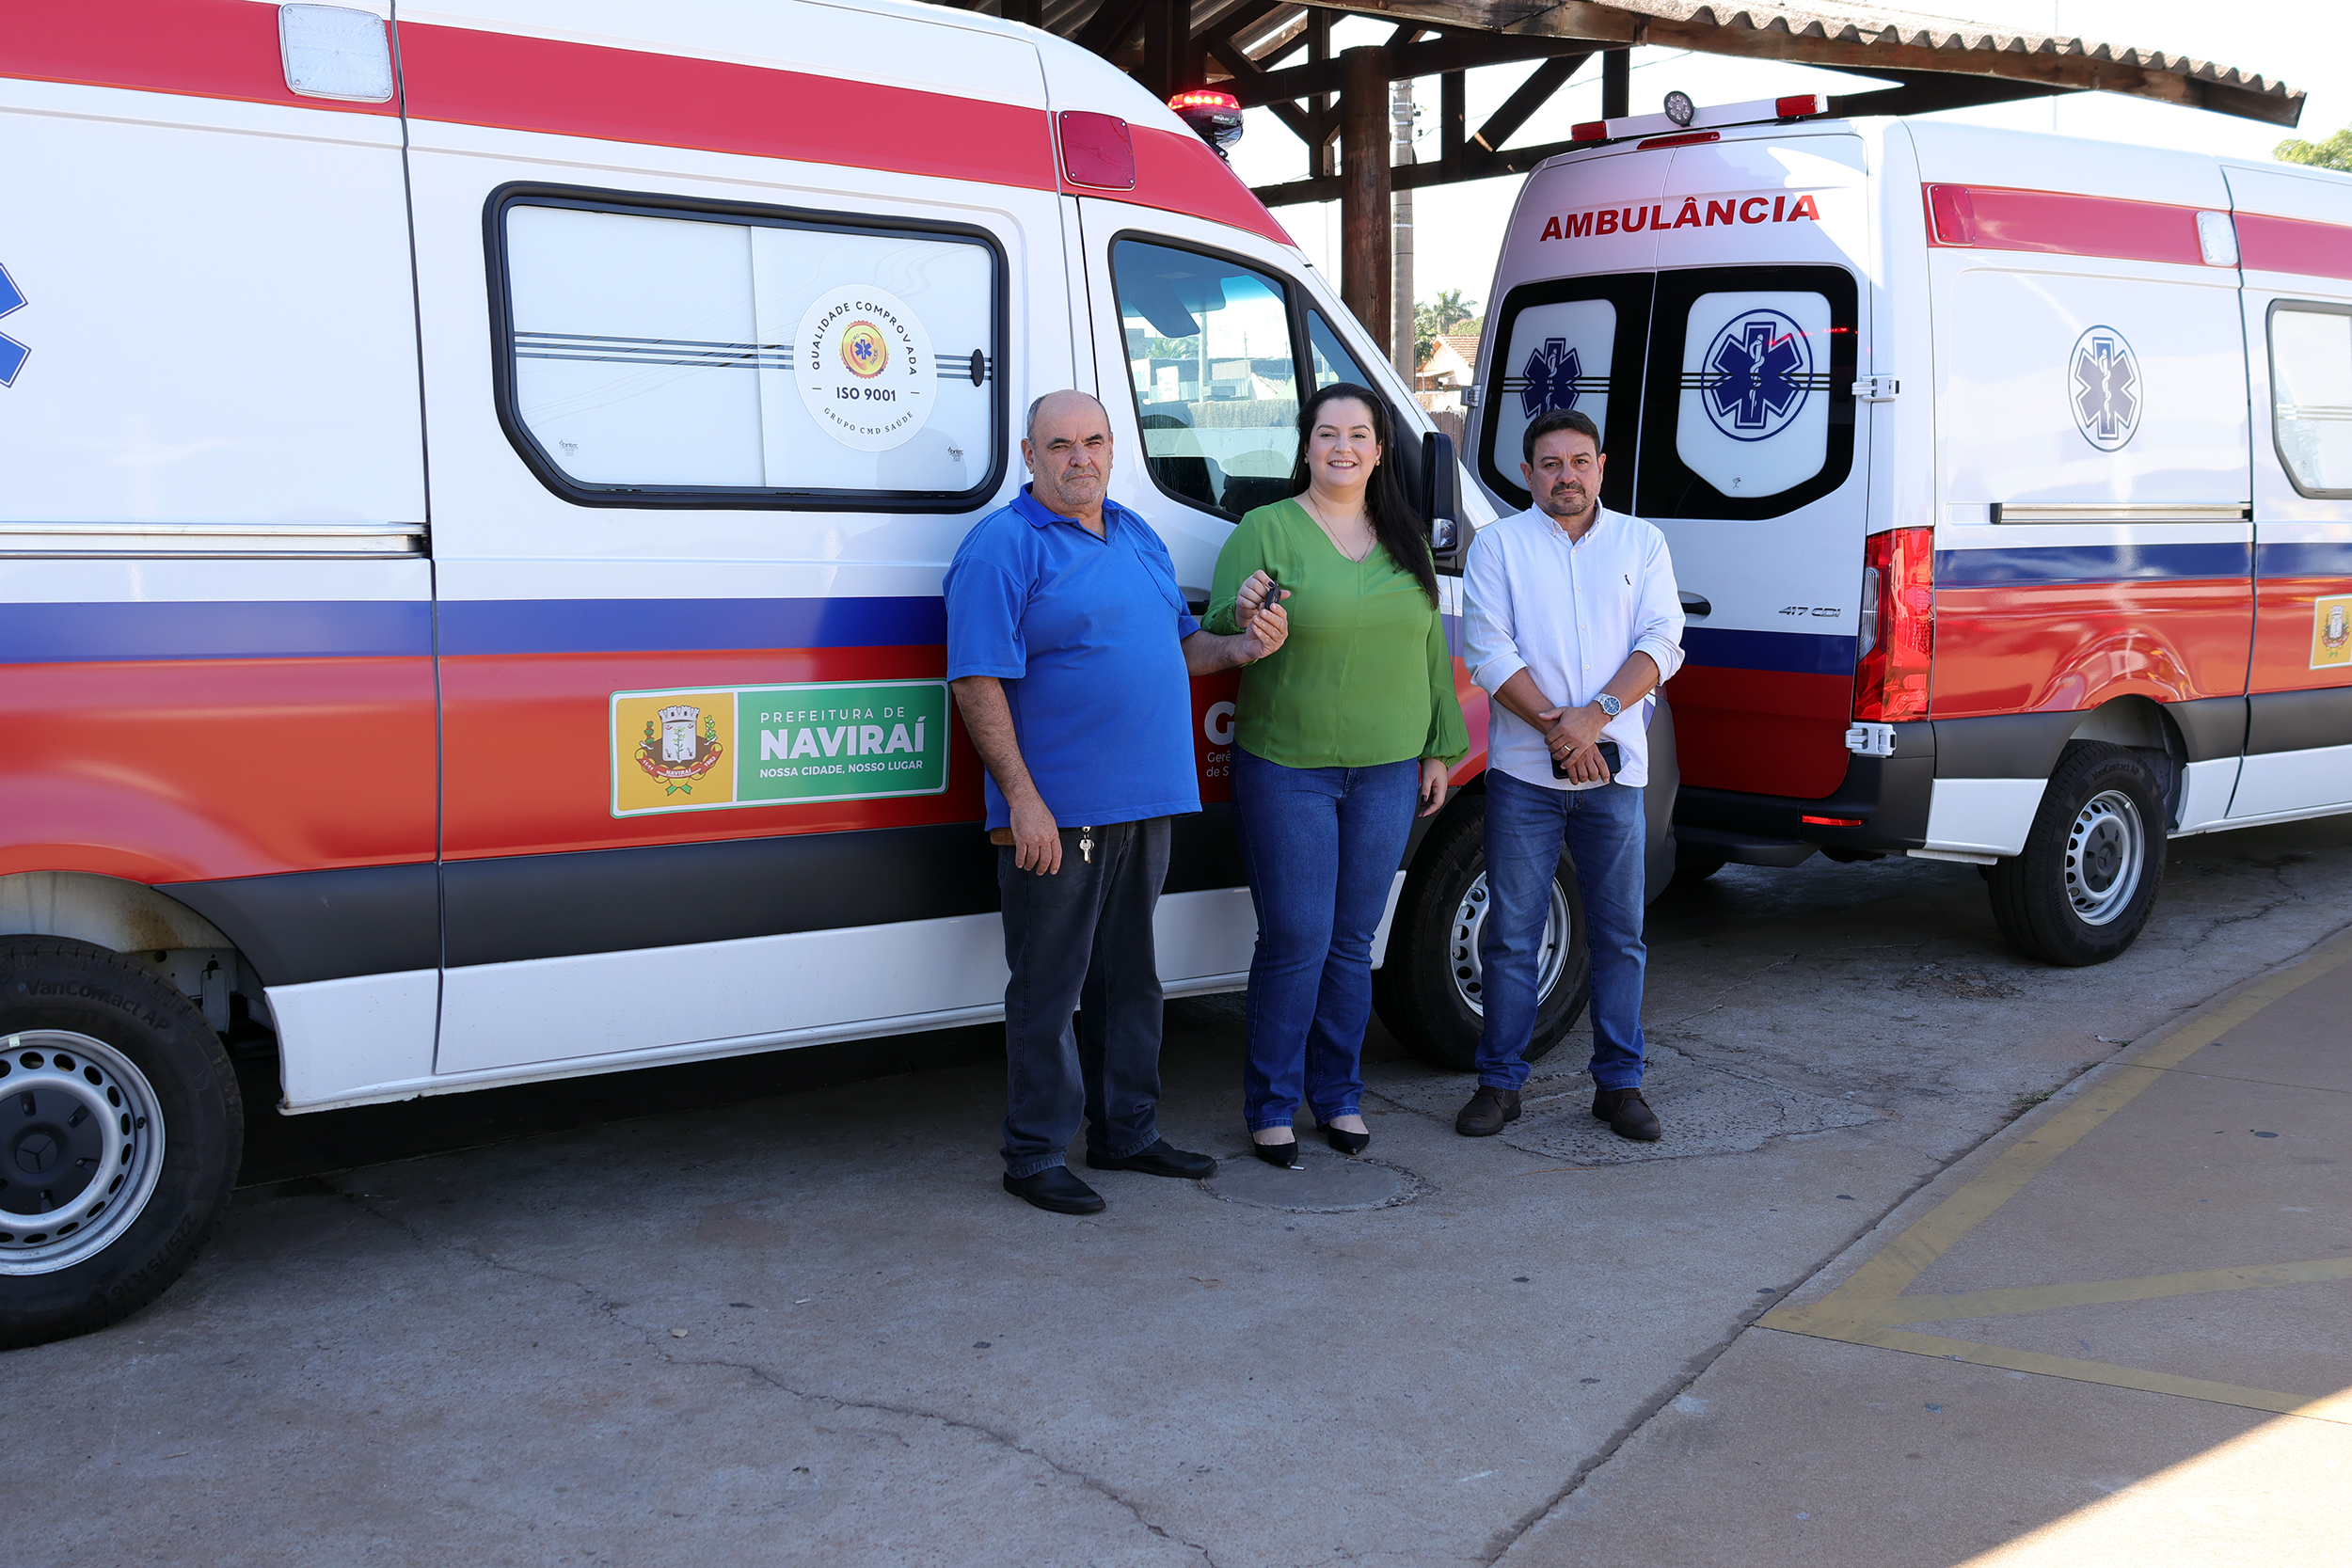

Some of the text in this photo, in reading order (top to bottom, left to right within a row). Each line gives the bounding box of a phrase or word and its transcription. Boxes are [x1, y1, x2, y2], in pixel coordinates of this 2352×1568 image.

[1539, 195, 1820, 242] AMBULÂNCIA
[811, 301, 917, 375] QUALIDADE COMPROVADA
[836, 387, 897, 402] ISO 9001
[823, 407, 914, 435] GRUPO CMD SAÚDE
[1778, 606, 1841, 618] 417 CDI
[760, 705, 905, 723] PREFEITURA DE
[760, 716, 927, 761] NAVIRAÍ
[759, 760, 924, 779] NOSSA CIDADE, NOSSO LUGAR
[1206, 767, 1219, 778] de
[25, 979, 170, 1031] VanContact AP
